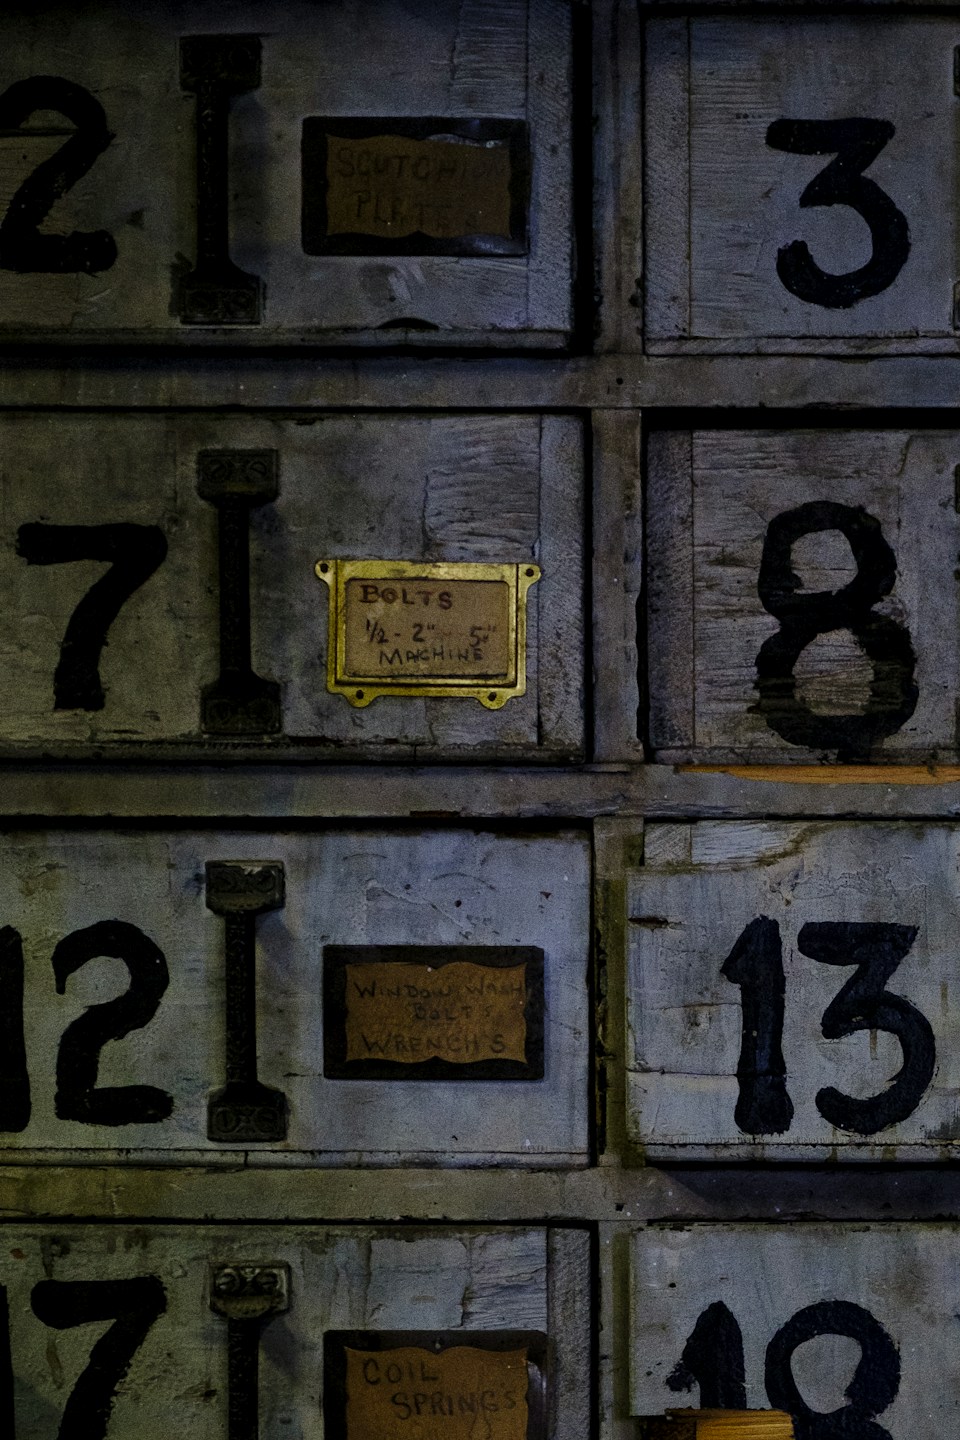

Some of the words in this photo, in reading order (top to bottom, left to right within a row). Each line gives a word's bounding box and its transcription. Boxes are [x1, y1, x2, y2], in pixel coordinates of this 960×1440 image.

[0, 76, 117, 272] 2
[766, 118, 910, 308] 3
[16, 523, 167, 709] 7
[359, 584, 453, 610] BOLTS
[379, 648, 483, 666] MACHINE
[755, 500, 918, 763] 8
[720, 916, 938, 1135] 13
[363, 1358, 439, 1385] COIL
